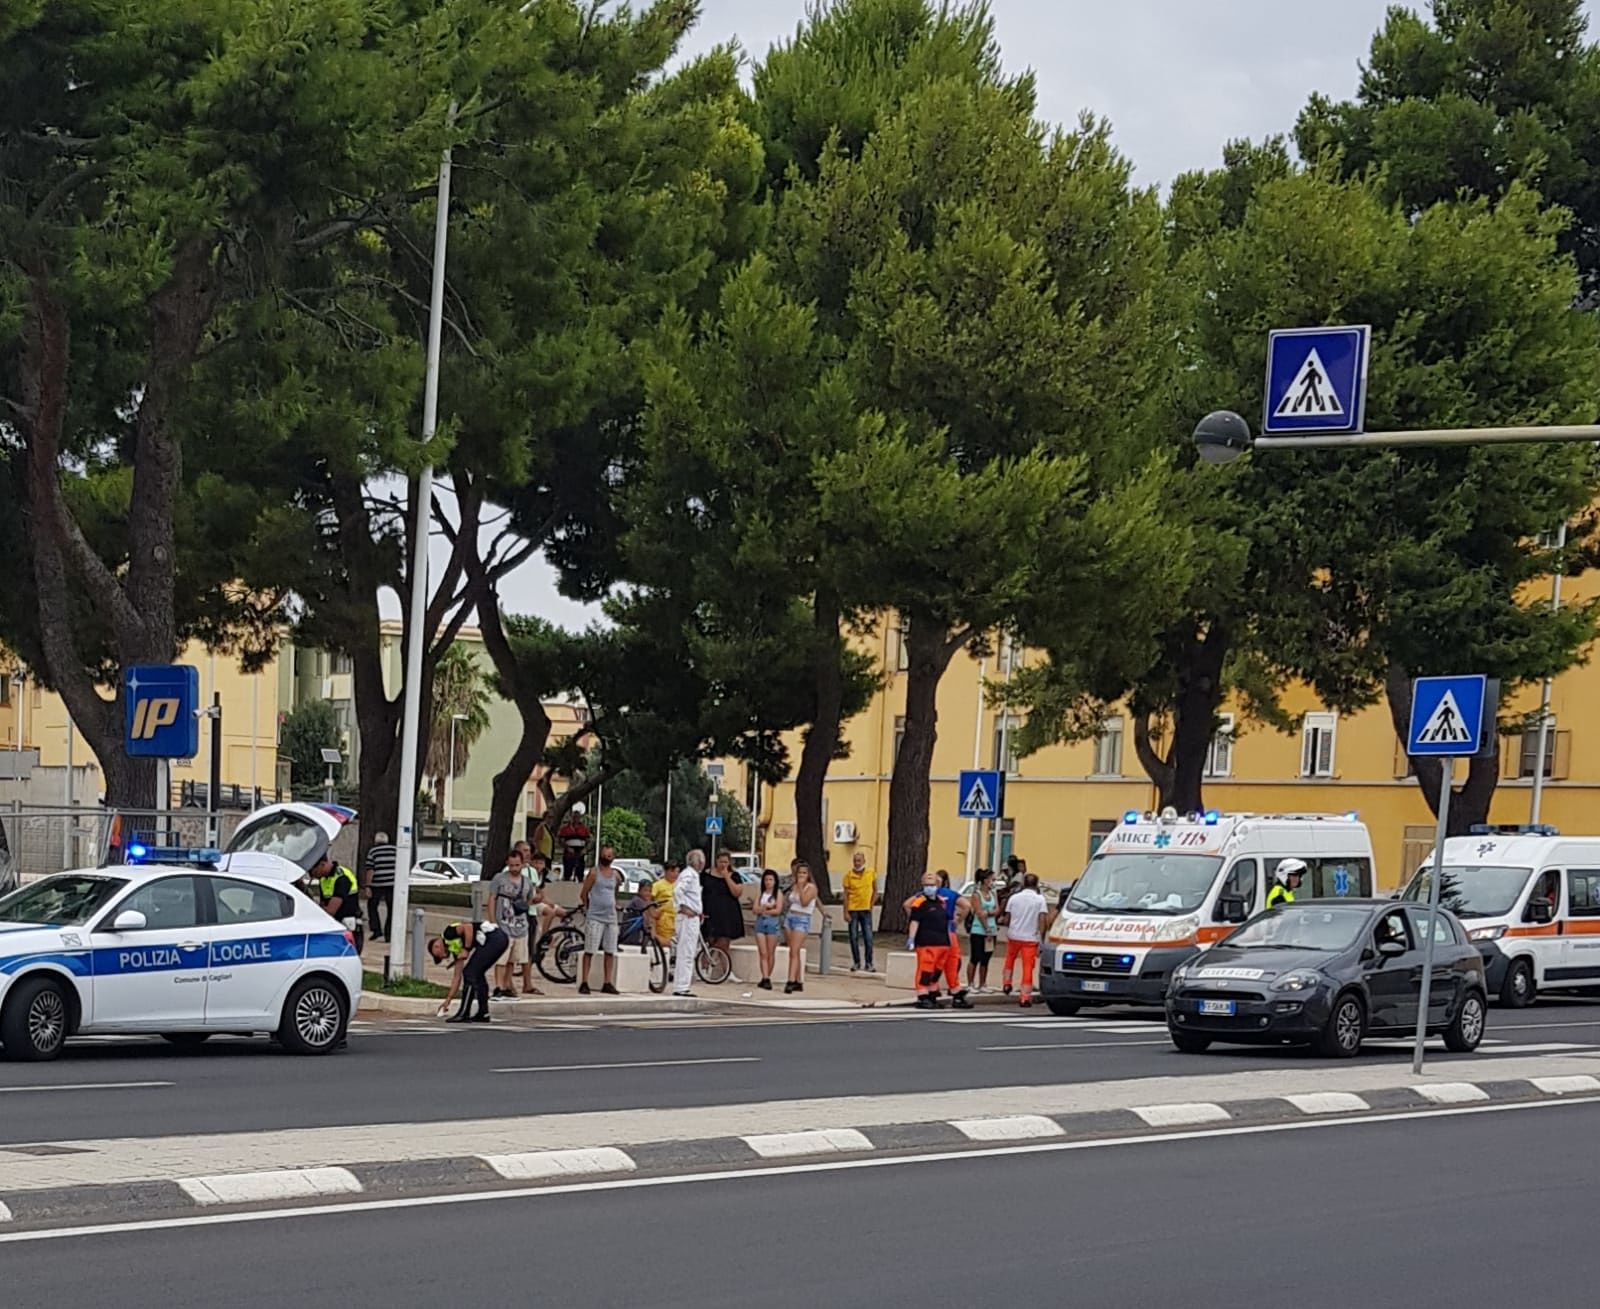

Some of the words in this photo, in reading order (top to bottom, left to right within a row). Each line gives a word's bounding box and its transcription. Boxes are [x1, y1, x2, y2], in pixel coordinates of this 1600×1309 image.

[131, 698, 180, 739] IP
[1114, 832, 1151, 844] MIKE
[119, 949, 182, 968] POLIZIA
[212, 942, 272, 962] LOCALE
[174, 976, 200, 984] Comune
